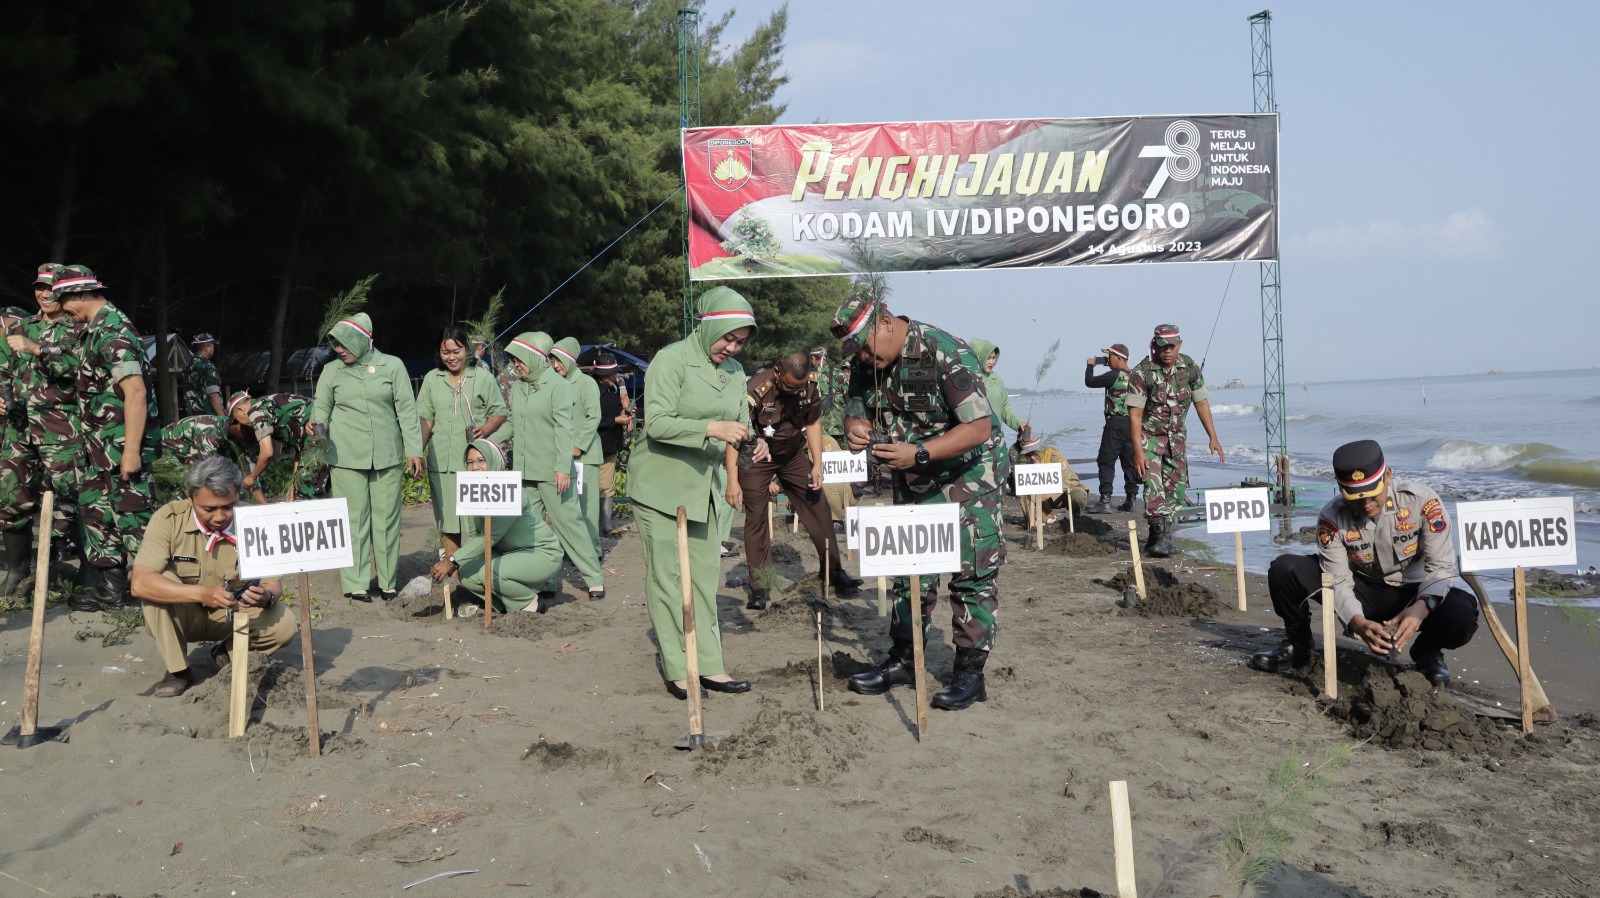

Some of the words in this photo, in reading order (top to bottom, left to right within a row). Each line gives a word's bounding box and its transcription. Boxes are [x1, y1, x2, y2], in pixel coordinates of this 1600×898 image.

[1209, 129, 1247, 140] TERUS
[1210, 141, 1256, 152] MELAJU
[1137, 119, 1201, 200] 78
[1210, 153, 1250, 163] UNTUK
[790, 140, 1110, 202] PENGHIJAUAN
[1211, 164, 1271, 175] INDONESIA
[1211, 177, 1243, 187] MAJU
[792, 208, 914, 241] KODAM
[926, 202, 1191, 237] IV/DIPONEGORO
[1087, 244, 1104, 255] 14
[1107, 242, 1165, 257] Agustus
[1168, 241, 1202, 252] 2023
[821, 459, 849, 475] KETUA
[1017, 470, 1060, 487] BAZNAS
[459, 483, 518, 503] PERSIT
[1209, 499, 1266, 521] DPRD
[243, 526, 275, 558] Plt.
[278, 518, 346, 554] BUPATI
[865, 522, 955, 557] DANDIM
[1464, 516, 1569, 551] KAPOLRES
